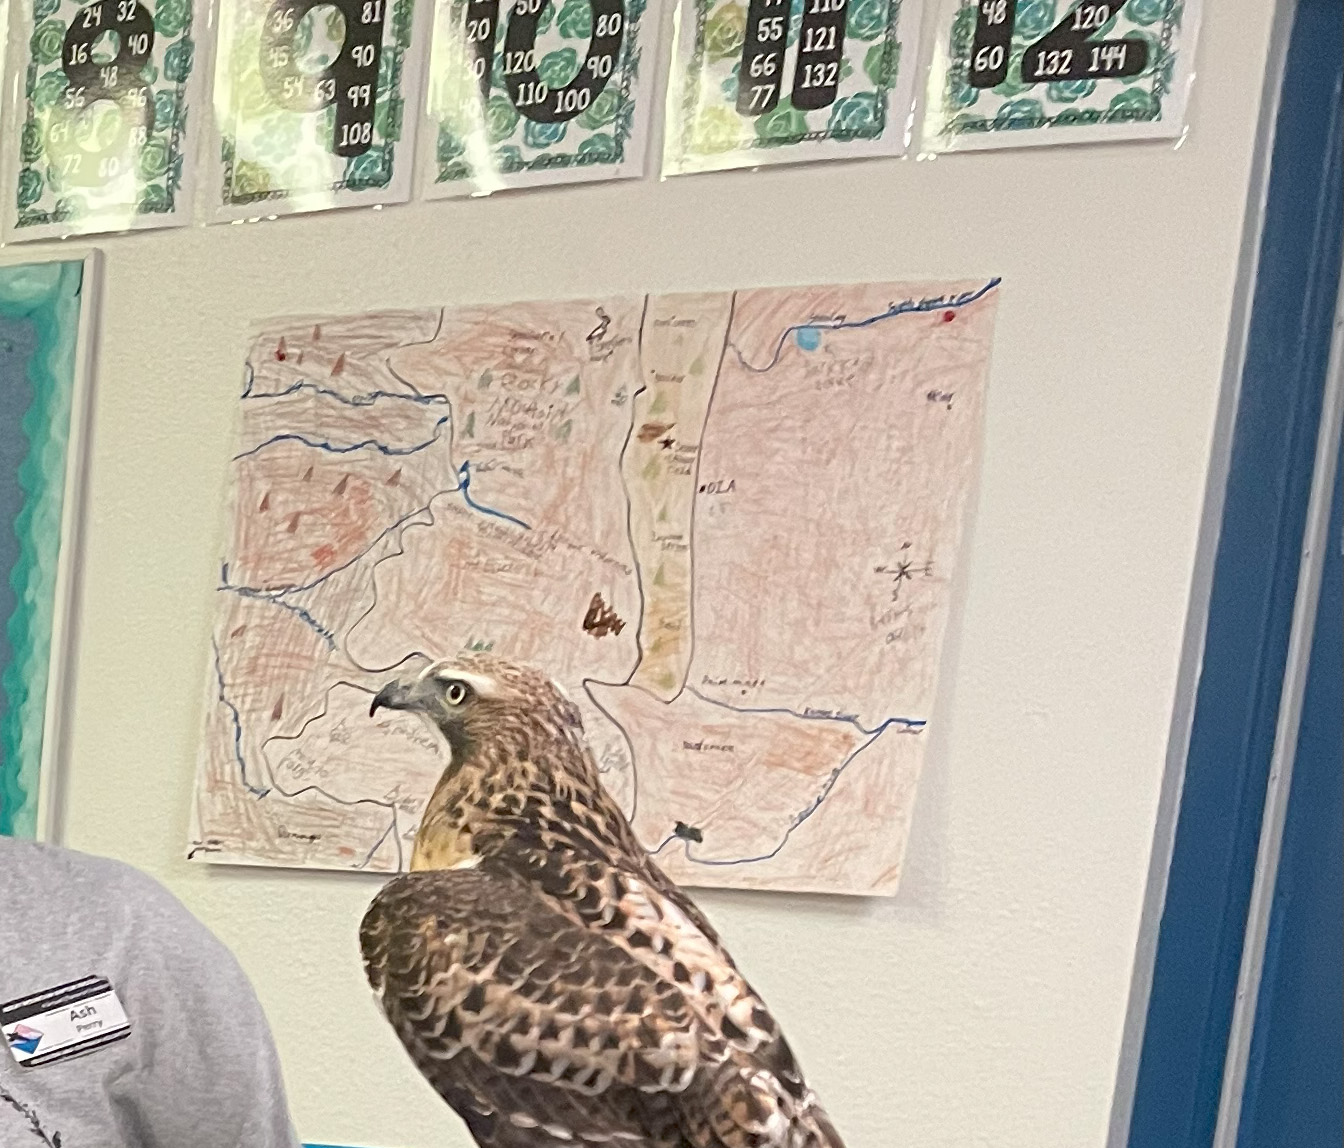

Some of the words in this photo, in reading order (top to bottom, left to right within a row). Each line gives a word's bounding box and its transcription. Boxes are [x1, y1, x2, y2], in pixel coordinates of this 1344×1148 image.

[82, 6, 101, 28] 24
[117, 2, 136, 21] 32
[362, 0, 381, 24] 81
[983, 0, 1006, 26] 48
[1072, 5, 1109, 30] 120
[467, 18, 491, 43] 20
[596, 13, 621, 37] 80
[758, 17, 783, 42] 55
[803, 26, 836, 52] 121
[352, 44, 374, 67] 90
[503, 50, 536, 75] 120
[587, 55, 612, 79] 90
[750, 53, 777, 77] 66
[975, 45, 1004, 71] 60
[1034, 50, 1073, 76] 132
[1088, 45, 1126, 72] 144
[802, 62, 838, 88] 132
[348, 84, 371, 107] 99
[516, 81, 548, 106] 110
[554, 88, 590, 114] 100
[750, 84, 775, 109] 77
[340, 122, 371, 147] 108
[71, 1006, 97, 1021] Ash
